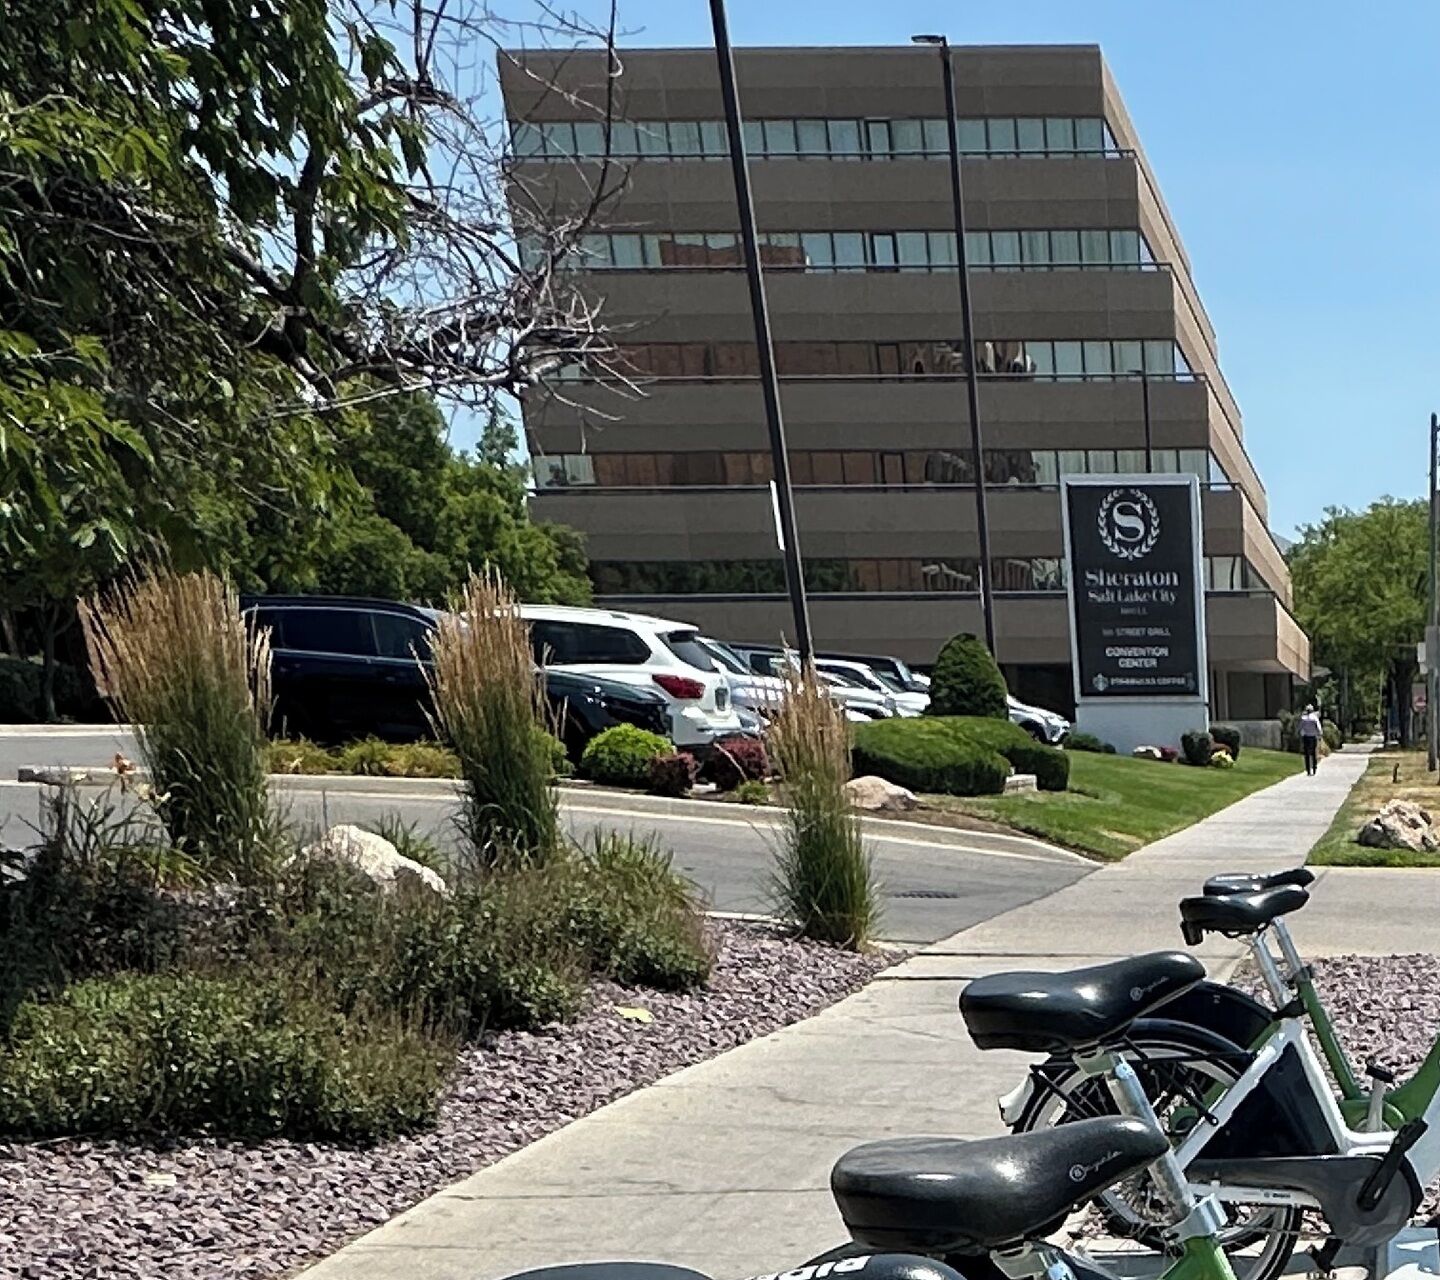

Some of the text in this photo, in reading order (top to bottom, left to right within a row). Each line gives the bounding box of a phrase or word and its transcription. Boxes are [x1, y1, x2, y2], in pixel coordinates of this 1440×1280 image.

[1085, 568, 1179, 587] Sheraton
[1088, 588, 1177, 606] Salt Lake City
[1106, 646, 1169, 657] CONVENTION
[1118, 657, 1157, 668] CENTER
